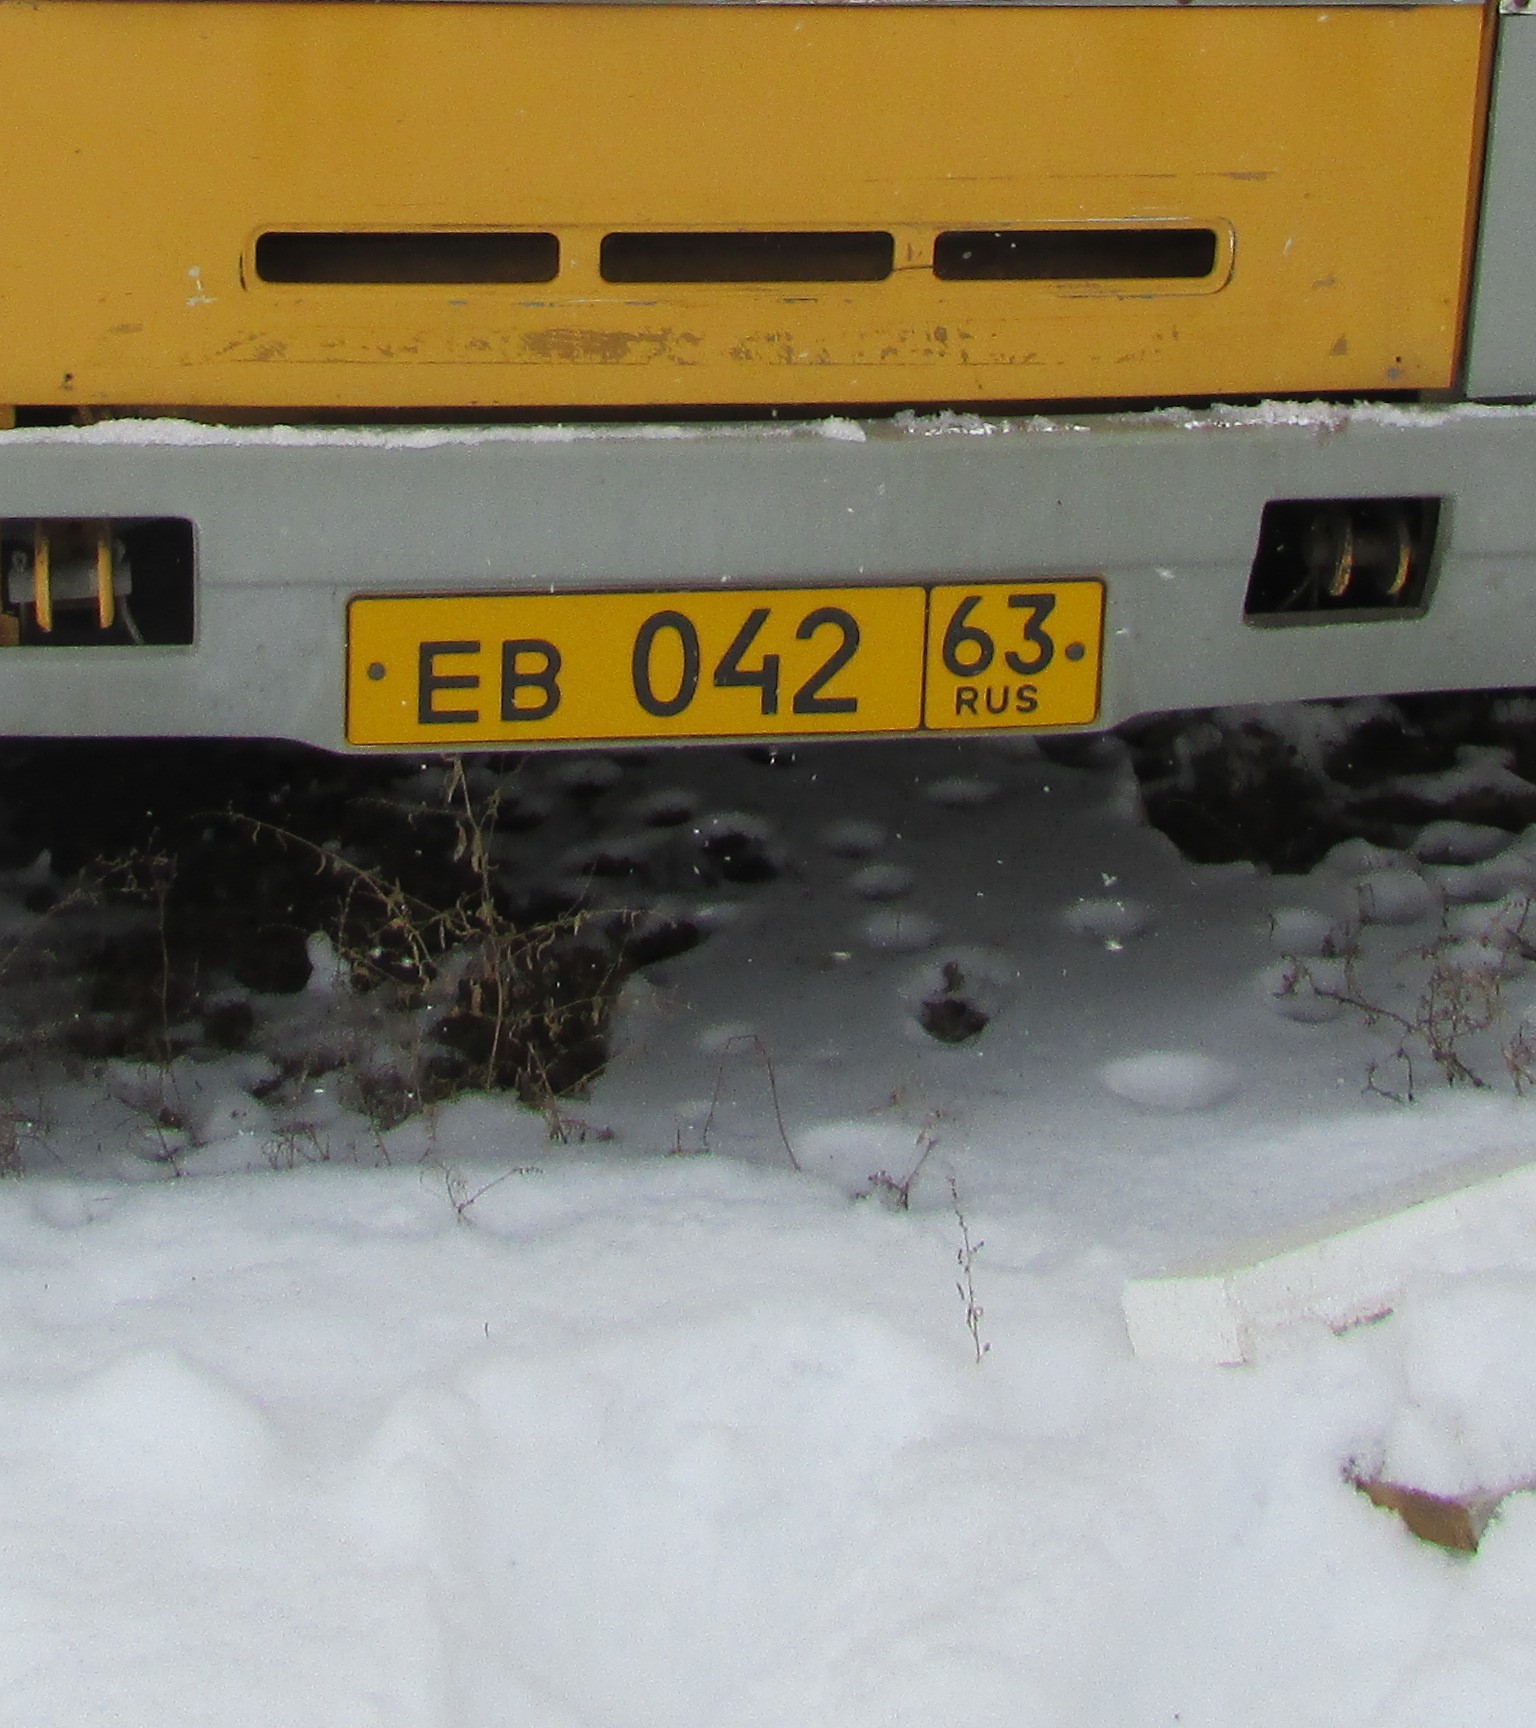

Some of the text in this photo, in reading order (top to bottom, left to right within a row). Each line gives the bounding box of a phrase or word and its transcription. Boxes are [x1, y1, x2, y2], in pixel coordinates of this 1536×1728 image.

[417, 607, 861, 725] EB 042
[941, 593, 1058, 677] 63
[954, 684, 1039, 715] RUS
